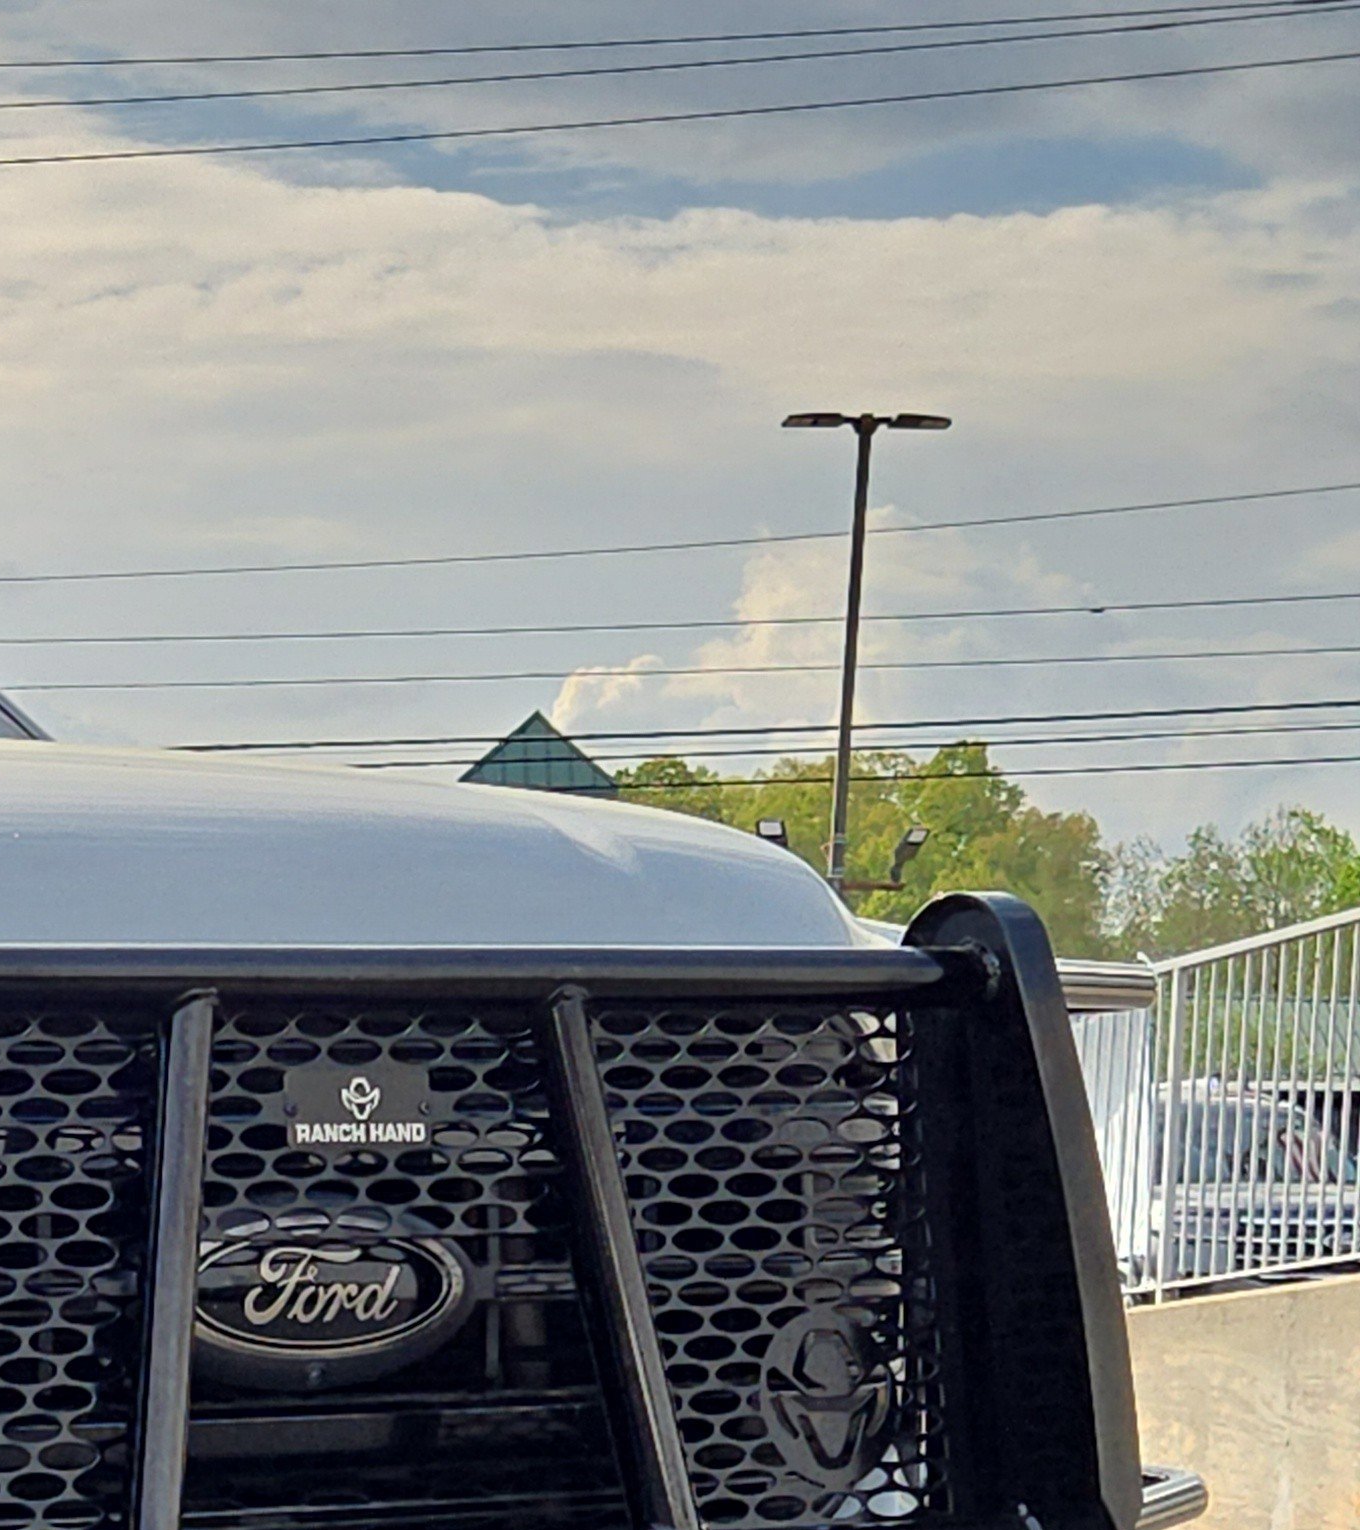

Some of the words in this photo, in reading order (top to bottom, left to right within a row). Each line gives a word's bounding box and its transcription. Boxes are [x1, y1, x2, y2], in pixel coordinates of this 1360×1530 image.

[295, 1122, 366, 1144] RANCH
[370, 1122, 426, 1143] HAND
[243, 1246, 401, 1325] Ford
